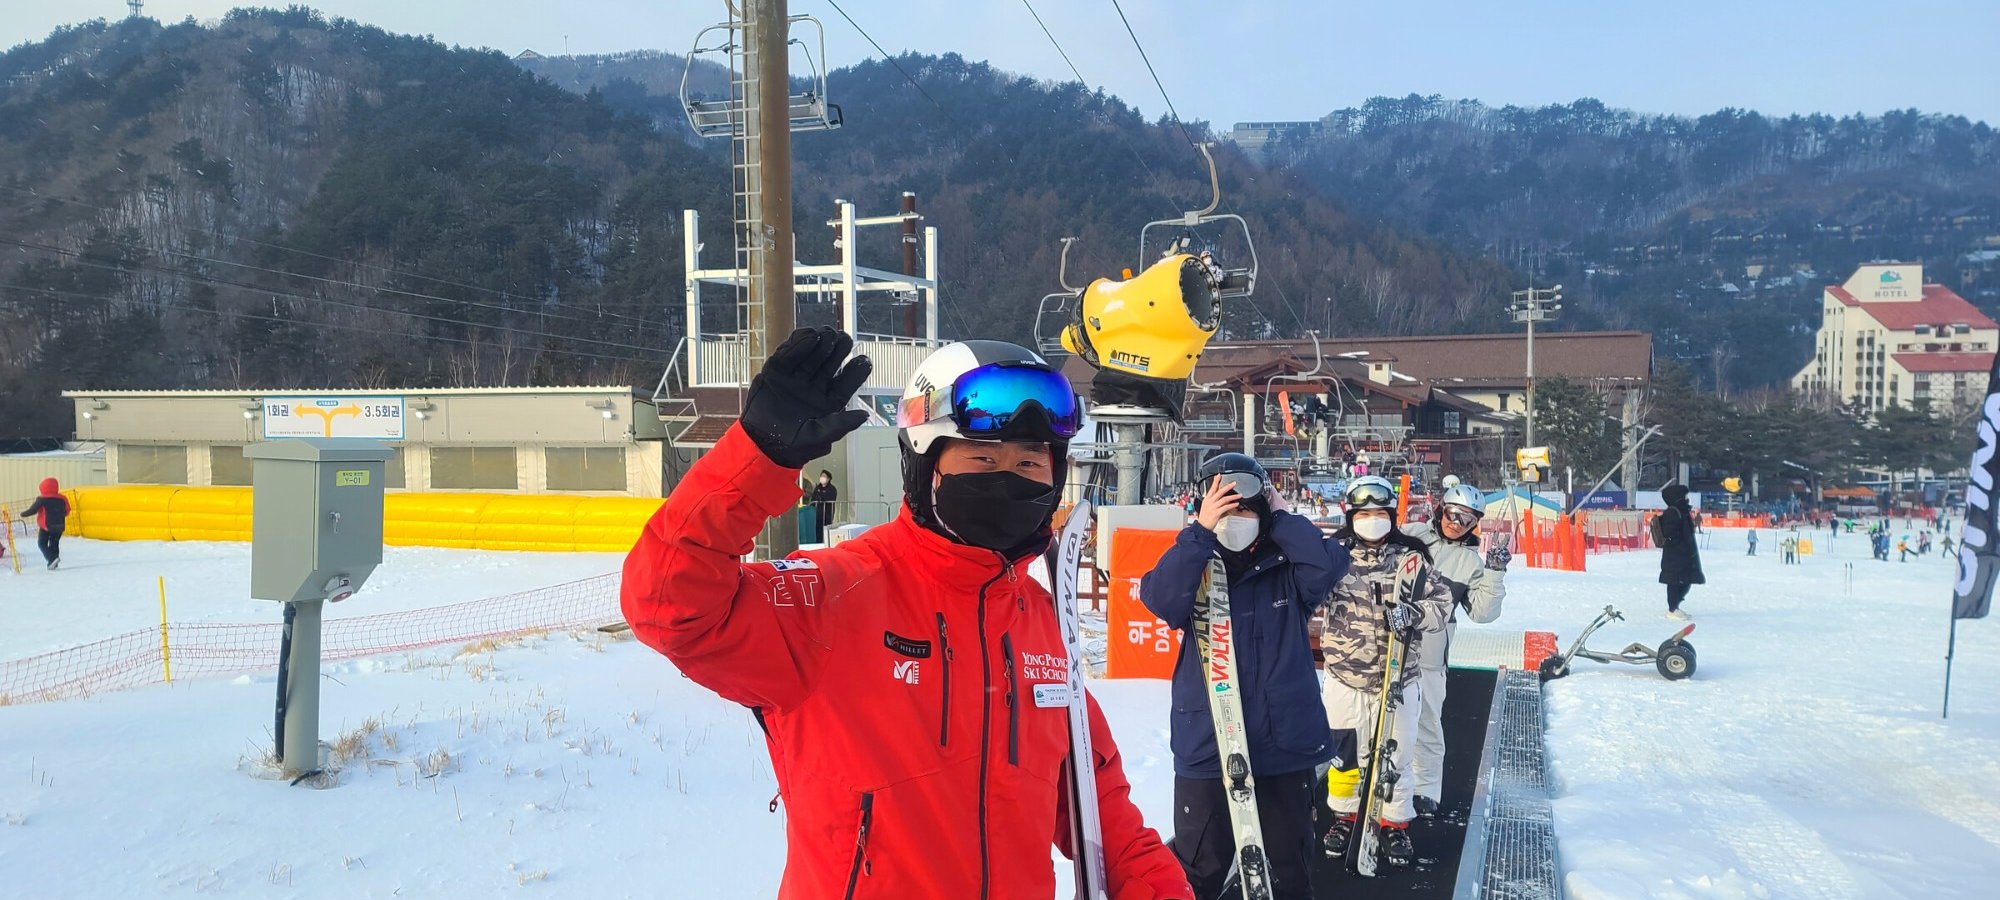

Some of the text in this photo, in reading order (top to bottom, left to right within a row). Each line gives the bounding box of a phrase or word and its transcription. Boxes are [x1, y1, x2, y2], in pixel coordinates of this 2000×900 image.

[1118, 351, 1150, 367] MTS
[914, 372, 936, 394] uve
[266, 404, 289, 417] 1회권
[364, 405, 400, 418] 3.5회권
[1023, 666, 1041, 679] SKI
